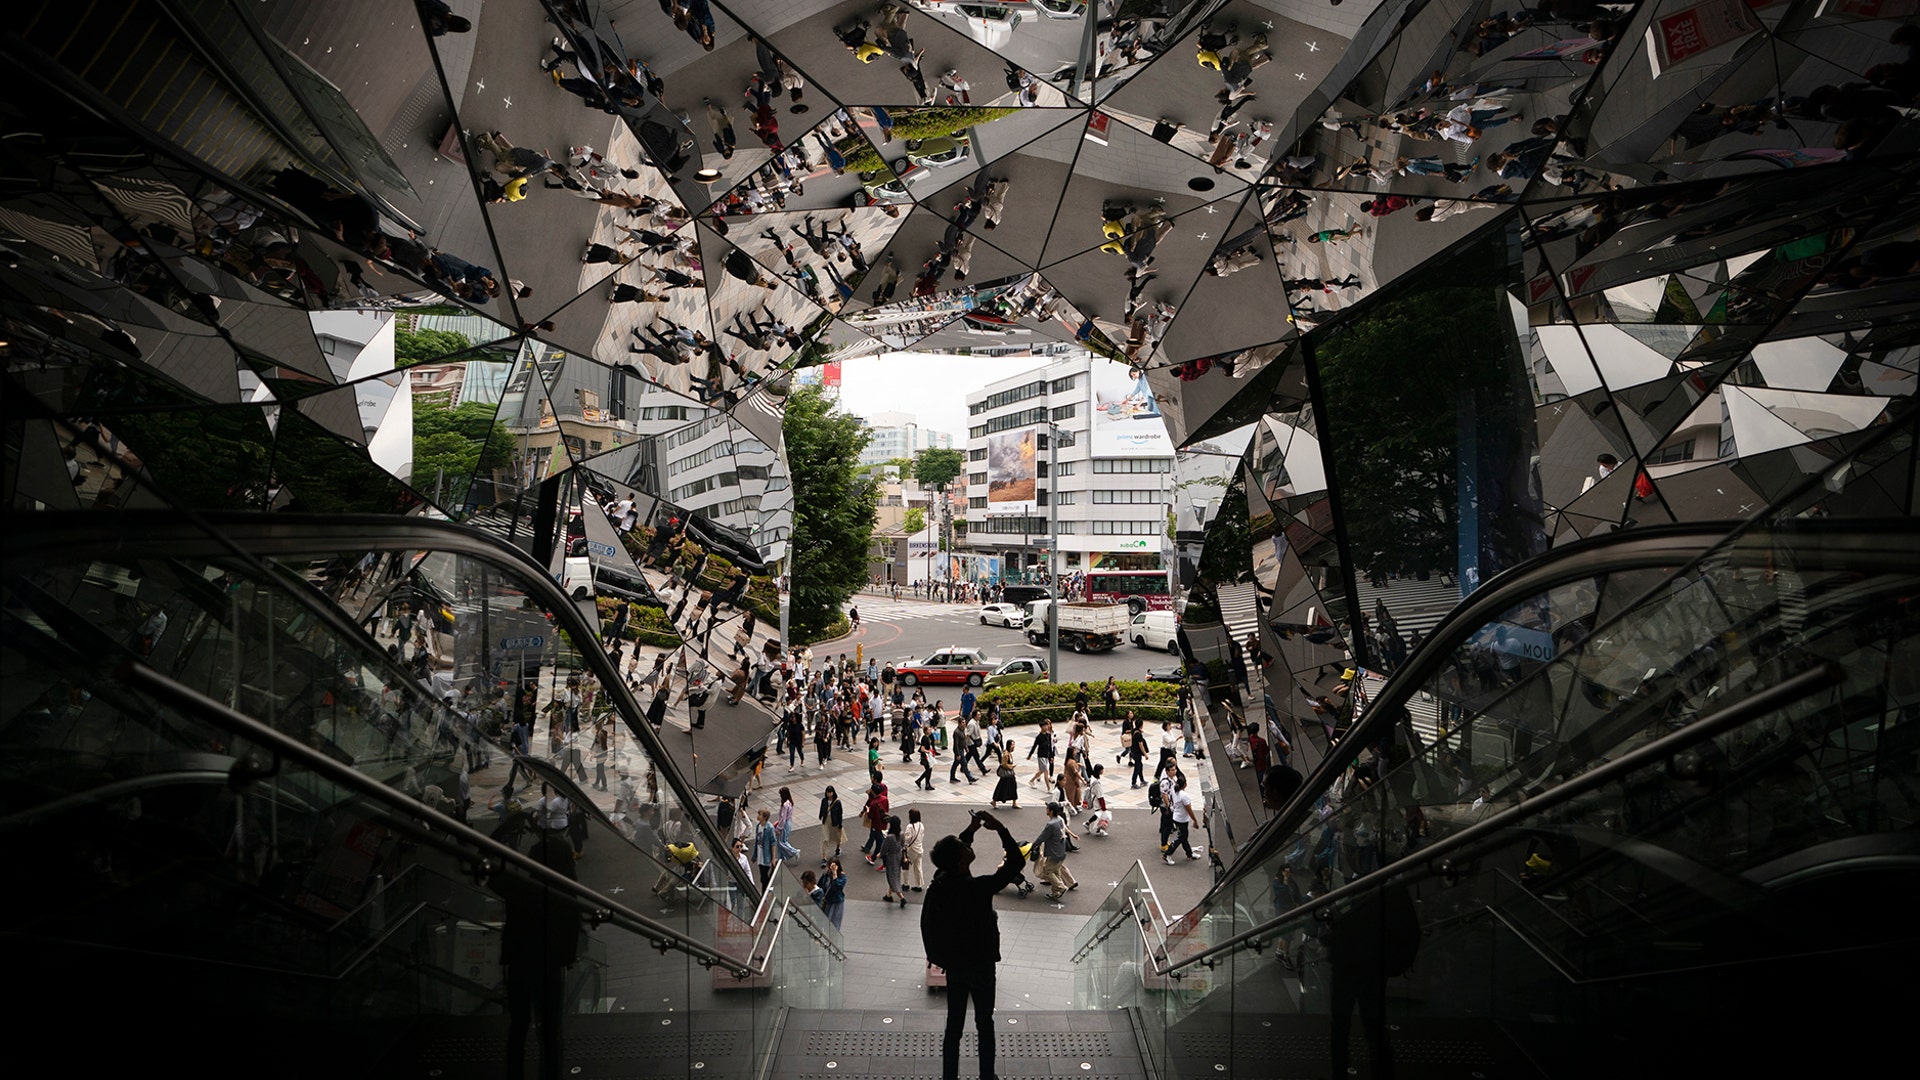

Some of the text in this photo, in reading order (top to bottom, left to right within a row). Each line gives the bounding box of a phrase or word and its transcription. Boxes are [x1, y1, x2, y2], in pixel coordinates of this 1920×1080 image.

[1668, 23, 1686, 55] TAX
[1681, 19, 1700, 49] FREE
[1523, 643, 1552, 661] MOU
